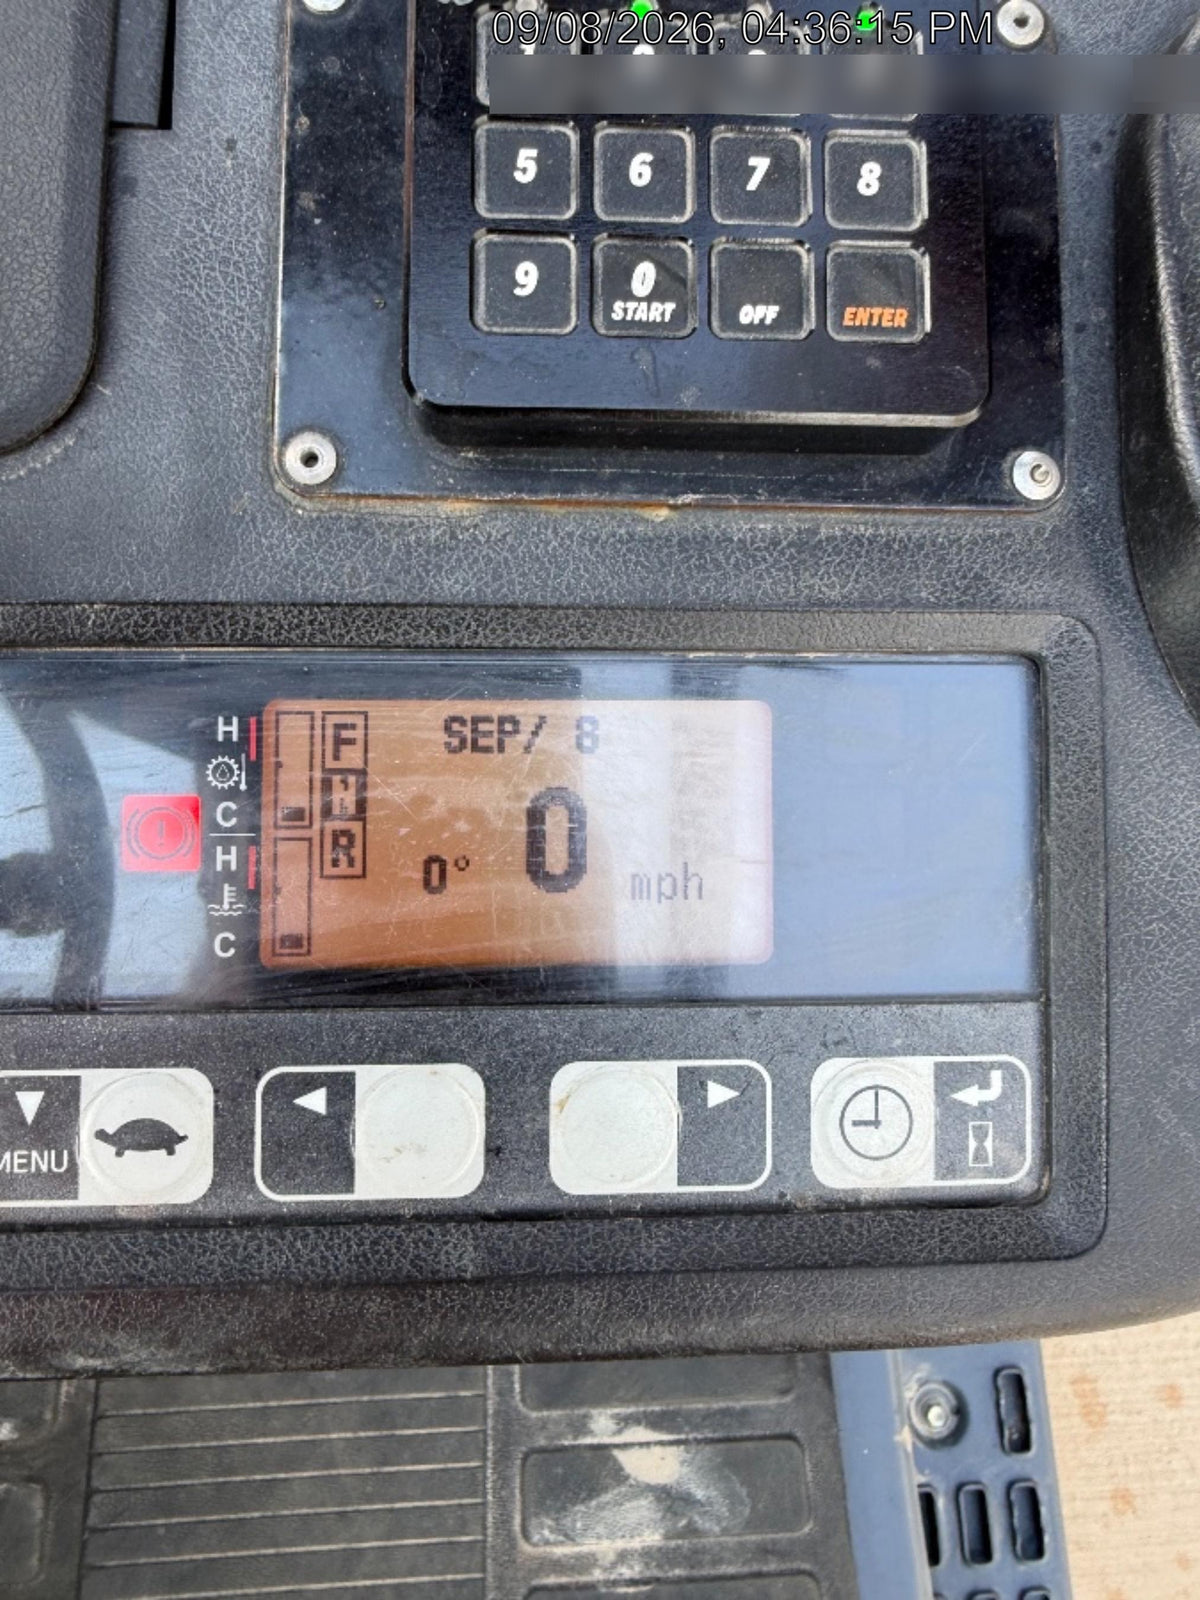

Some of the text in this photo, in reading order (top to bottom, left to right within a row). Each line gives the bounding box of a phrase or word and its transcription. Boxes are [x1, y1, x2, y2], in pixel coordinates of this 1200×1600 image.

[514, 149, 537, 183] 5
[628, 153, 653, 187] 6
[746, 157, 770, 190] 7
[856, 161, 882, 196] 8
[513, 261, 538, 297] 9
[631, 261, 656, 297] 0
[611, 300, 676, 324] START
[739, 305, 780, 326] OFF
[843, 306, 909, 328] ENTER
[217, 716, 239, 742] H
[332, 723, 357, 762] F
[443, 715, 599, 754] SEP/ 8
[215, 801, 238, 828] C
[331, 829, 356, 868] R
[525, 786, 588, 893] 0
[216, 845, 237, 871] H
[631, 862, 703, 904] mph
[214, 931, 236, 958] C
